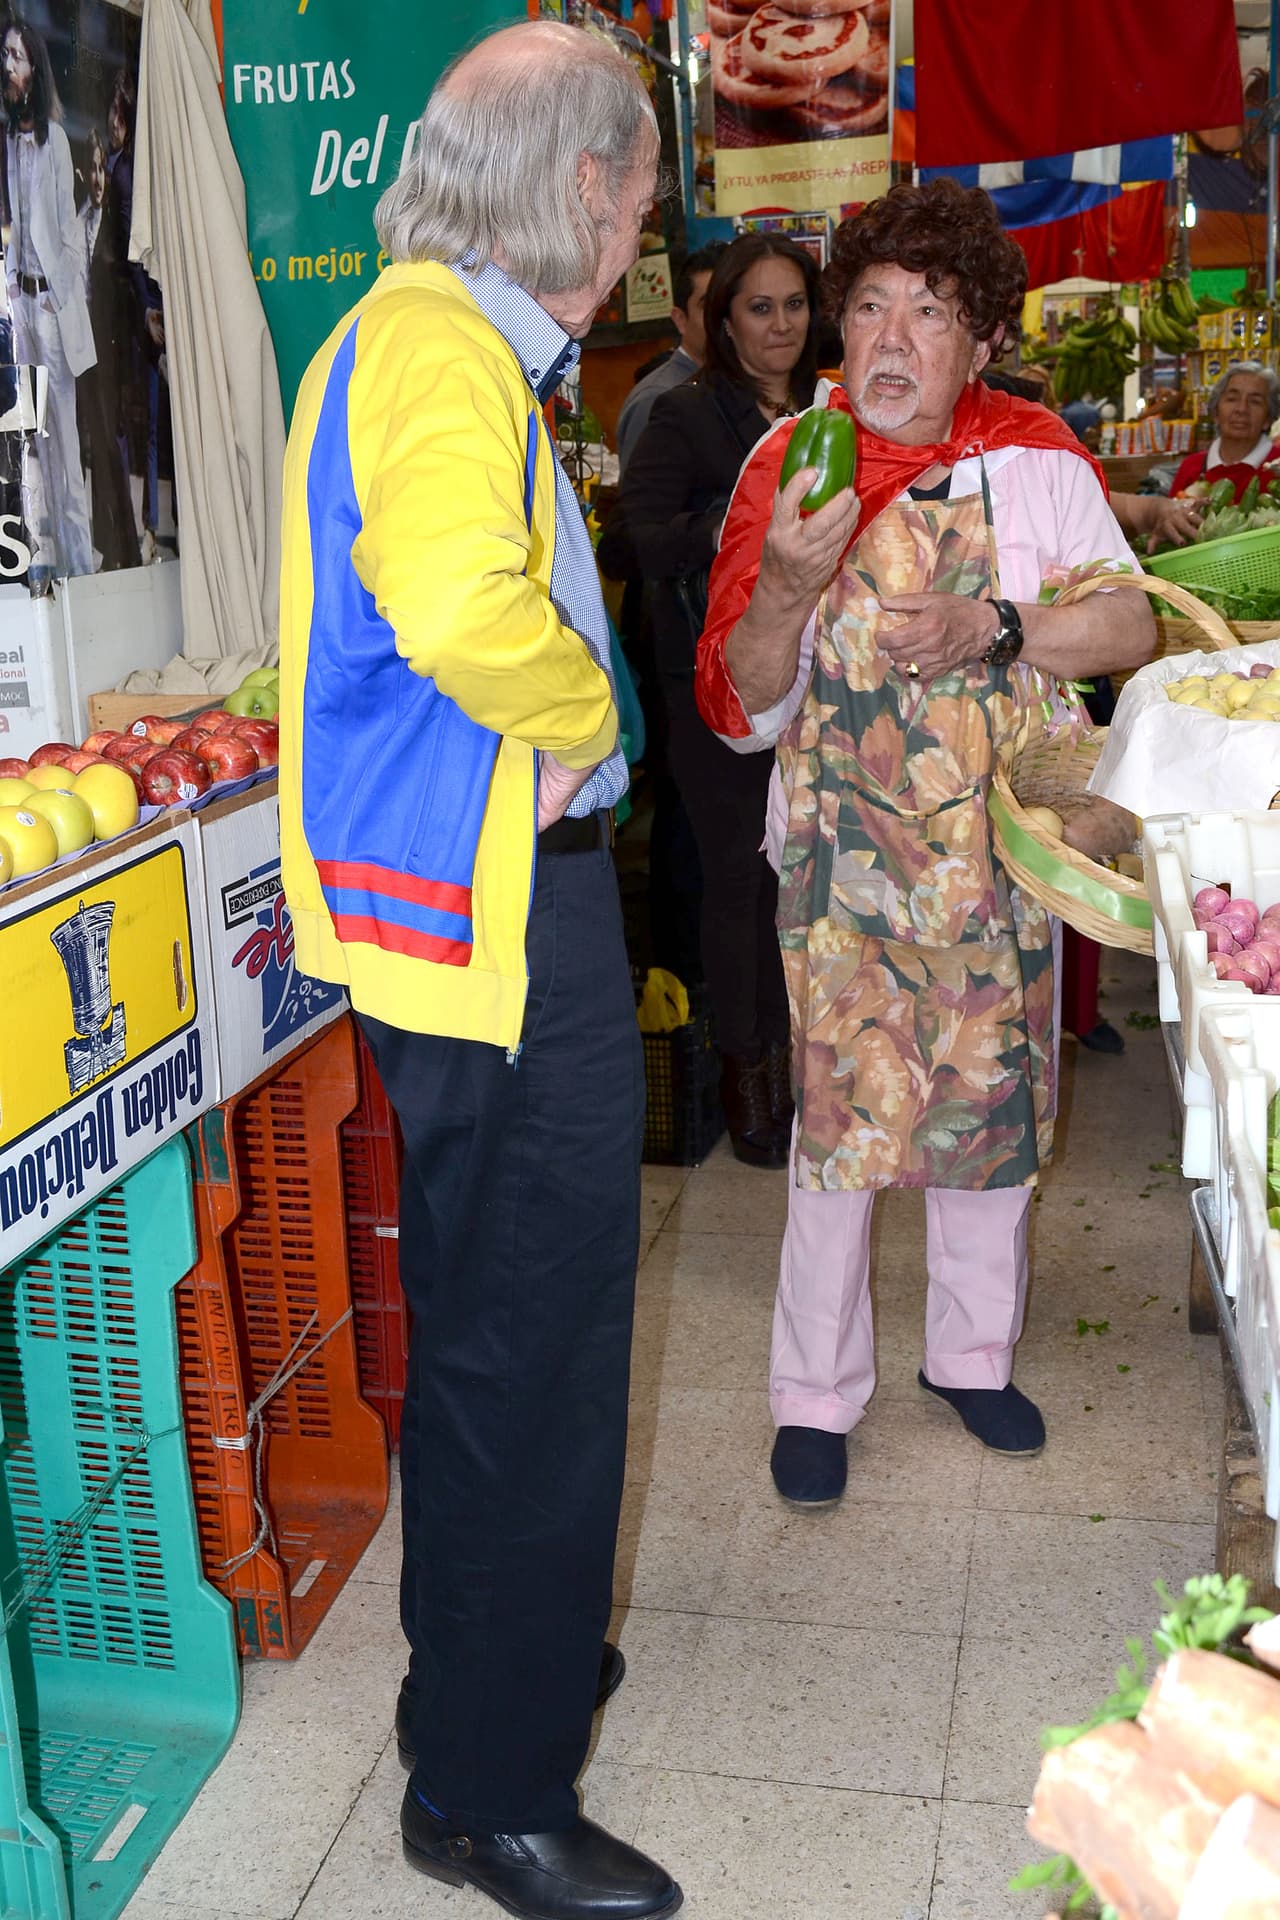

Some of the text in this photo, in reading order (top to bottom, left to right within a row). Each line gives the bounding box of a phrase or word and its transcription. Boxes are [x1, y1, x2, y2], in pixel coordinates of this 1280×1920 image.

[233, 59, 356, 104] FRUTAS
[310, 113, 389, 196] Del
[756, 175, 768, 185] YA
[288, 248, 367, 283] mejor
[230, 883, 270, 912] EXPERIENCE
[121, 1028, 203, 1137] Golden
